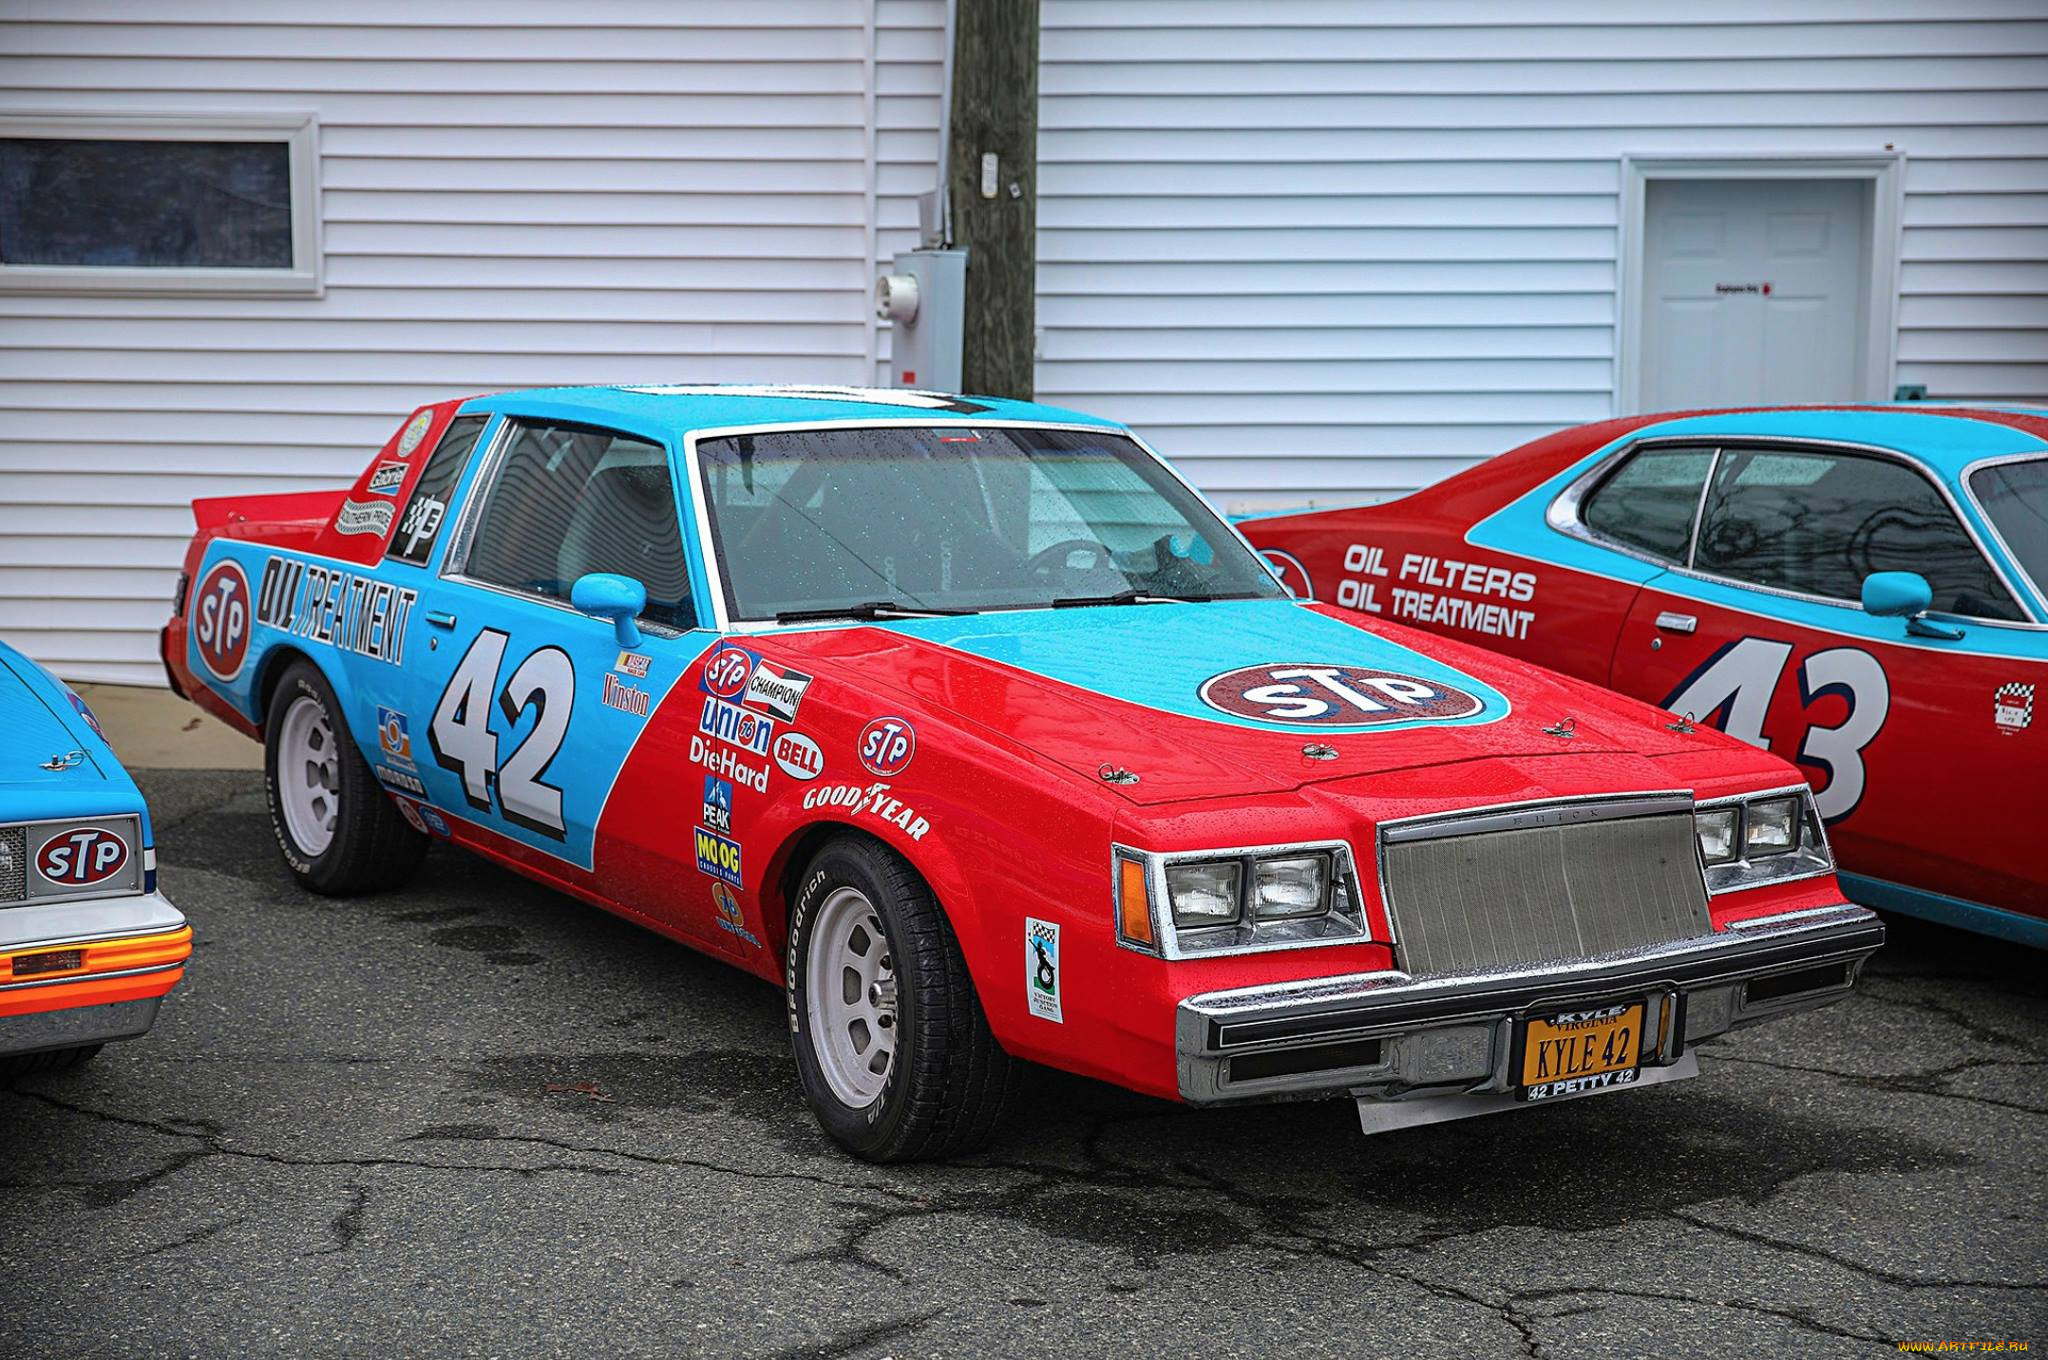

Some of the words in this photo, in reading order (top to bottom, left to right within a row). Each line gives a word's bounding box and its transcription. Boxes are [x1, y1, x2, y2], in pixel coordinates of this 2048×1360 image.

[1342, 543, 1389, 577] OIL
[1398, 552, 1538, 602] FILTERS
[199, 577, 247, 658] STP
[256, 555, 307, 631] OIL
[292, 560, 419, 667] TREATMENT
[1336, 579, 1383, 613] OIL
[1391, 587, 1536, 640] TREATMENT
[602, 672, 650, 717] Winston
[707, 652, 748, 690] STP
[750, 676, 800, 707] CHAMPION
[1242, 668, 1442, 720] STP
[427, 626, 576, 843] 42
[863, 723, 908, 767] STP
[1660, 636, 1891, 827] 43
[689, 735, 769, 794] DieHard
[776, 737, 818, 775] BELL
[703, 803, 731, 830] PEAK
[46, 831, 121, 881] STP
[697, 832, 739, 874] MOOG
[719, 895, 739, 917] 76
[1557, 1004, 1624, 1024] KYLE
[1535, 1033, 1597, 1079] KYLE
[1602, 1027, 1631, 1067] 42
[1528, 1085, 1548, 1101] 42
[1552, 1075, 1612, 1096] PETTY
[1615, 1069, 1635, 1084] 42
